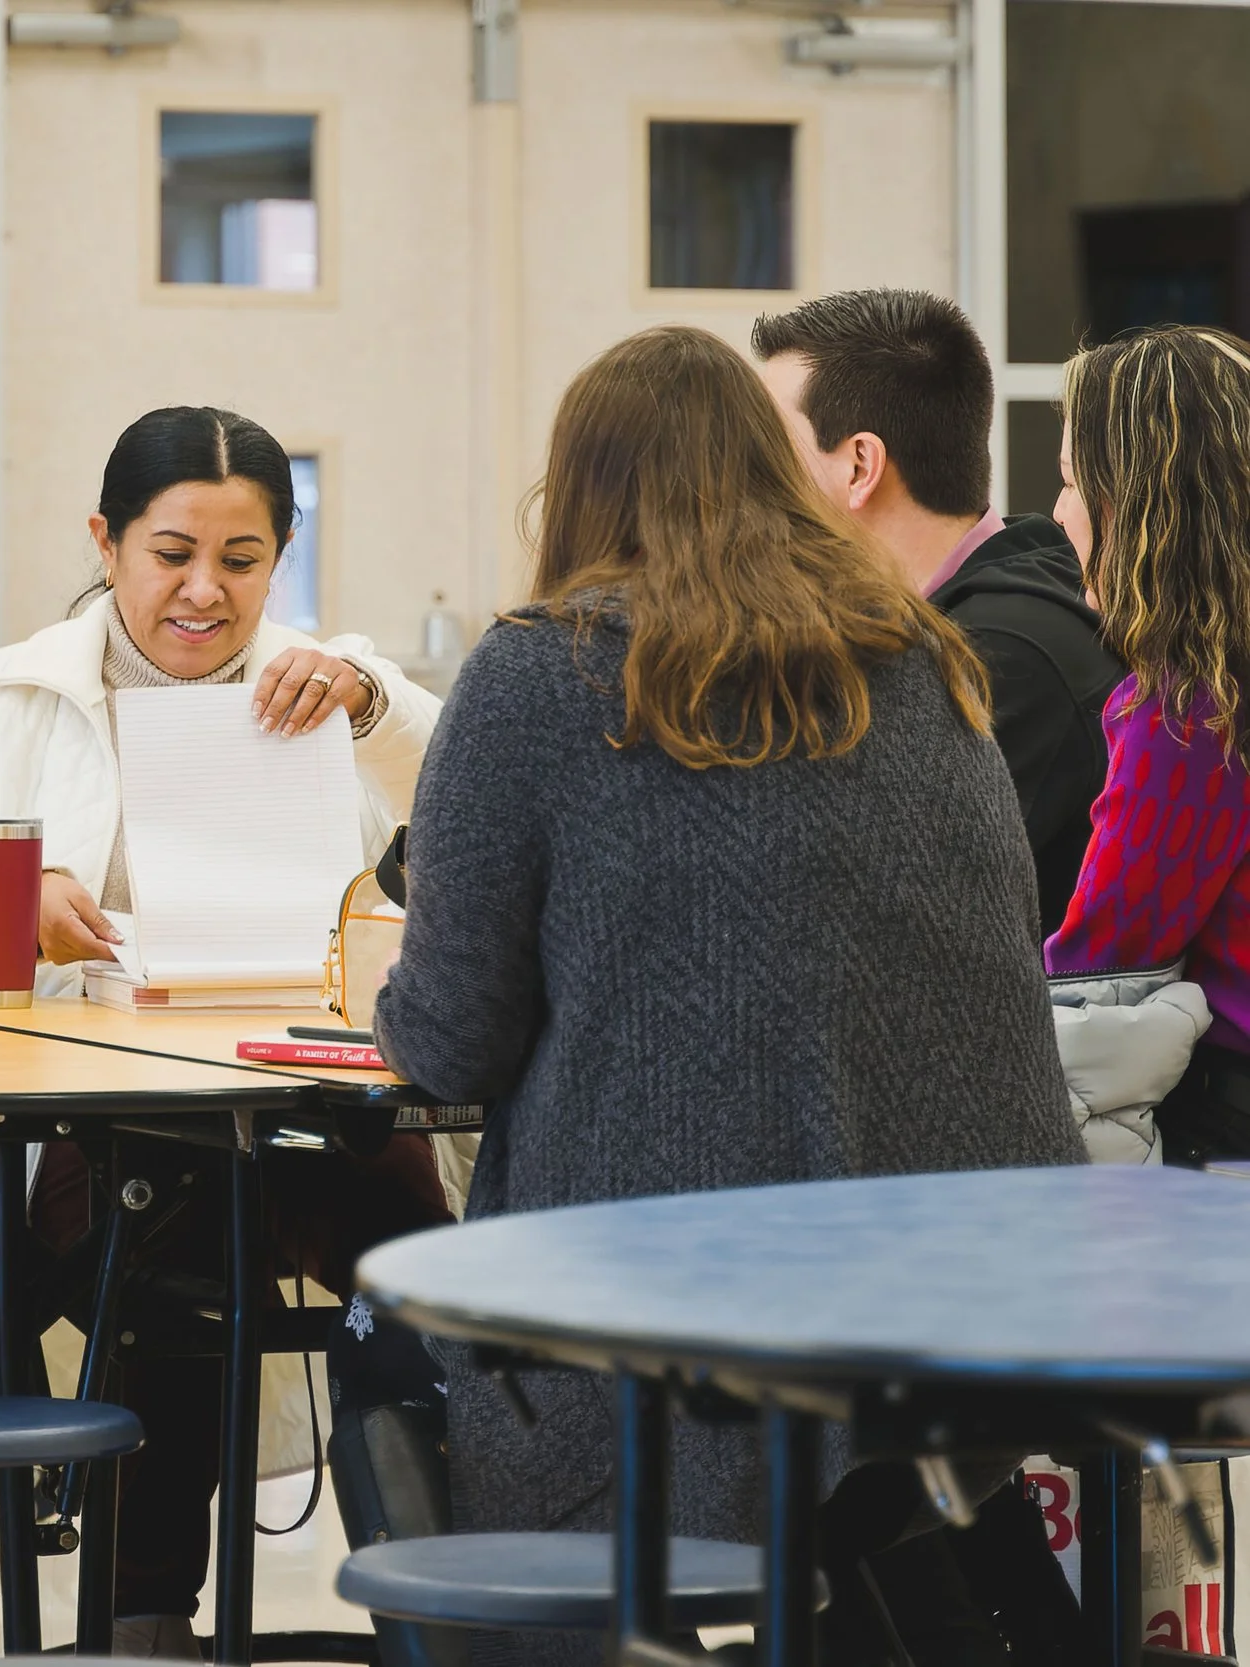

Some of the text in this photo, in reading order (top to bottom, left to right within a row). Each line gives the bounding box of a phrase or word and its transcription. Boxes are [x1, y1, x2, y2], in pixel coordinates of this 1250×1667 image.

[295, 1049, 301, 1057] A
[302, 1050, 328, 1059] FAMILY
[329, 1051, 340, 1059] OF
[341, 1049, 366, 1062] Faith
